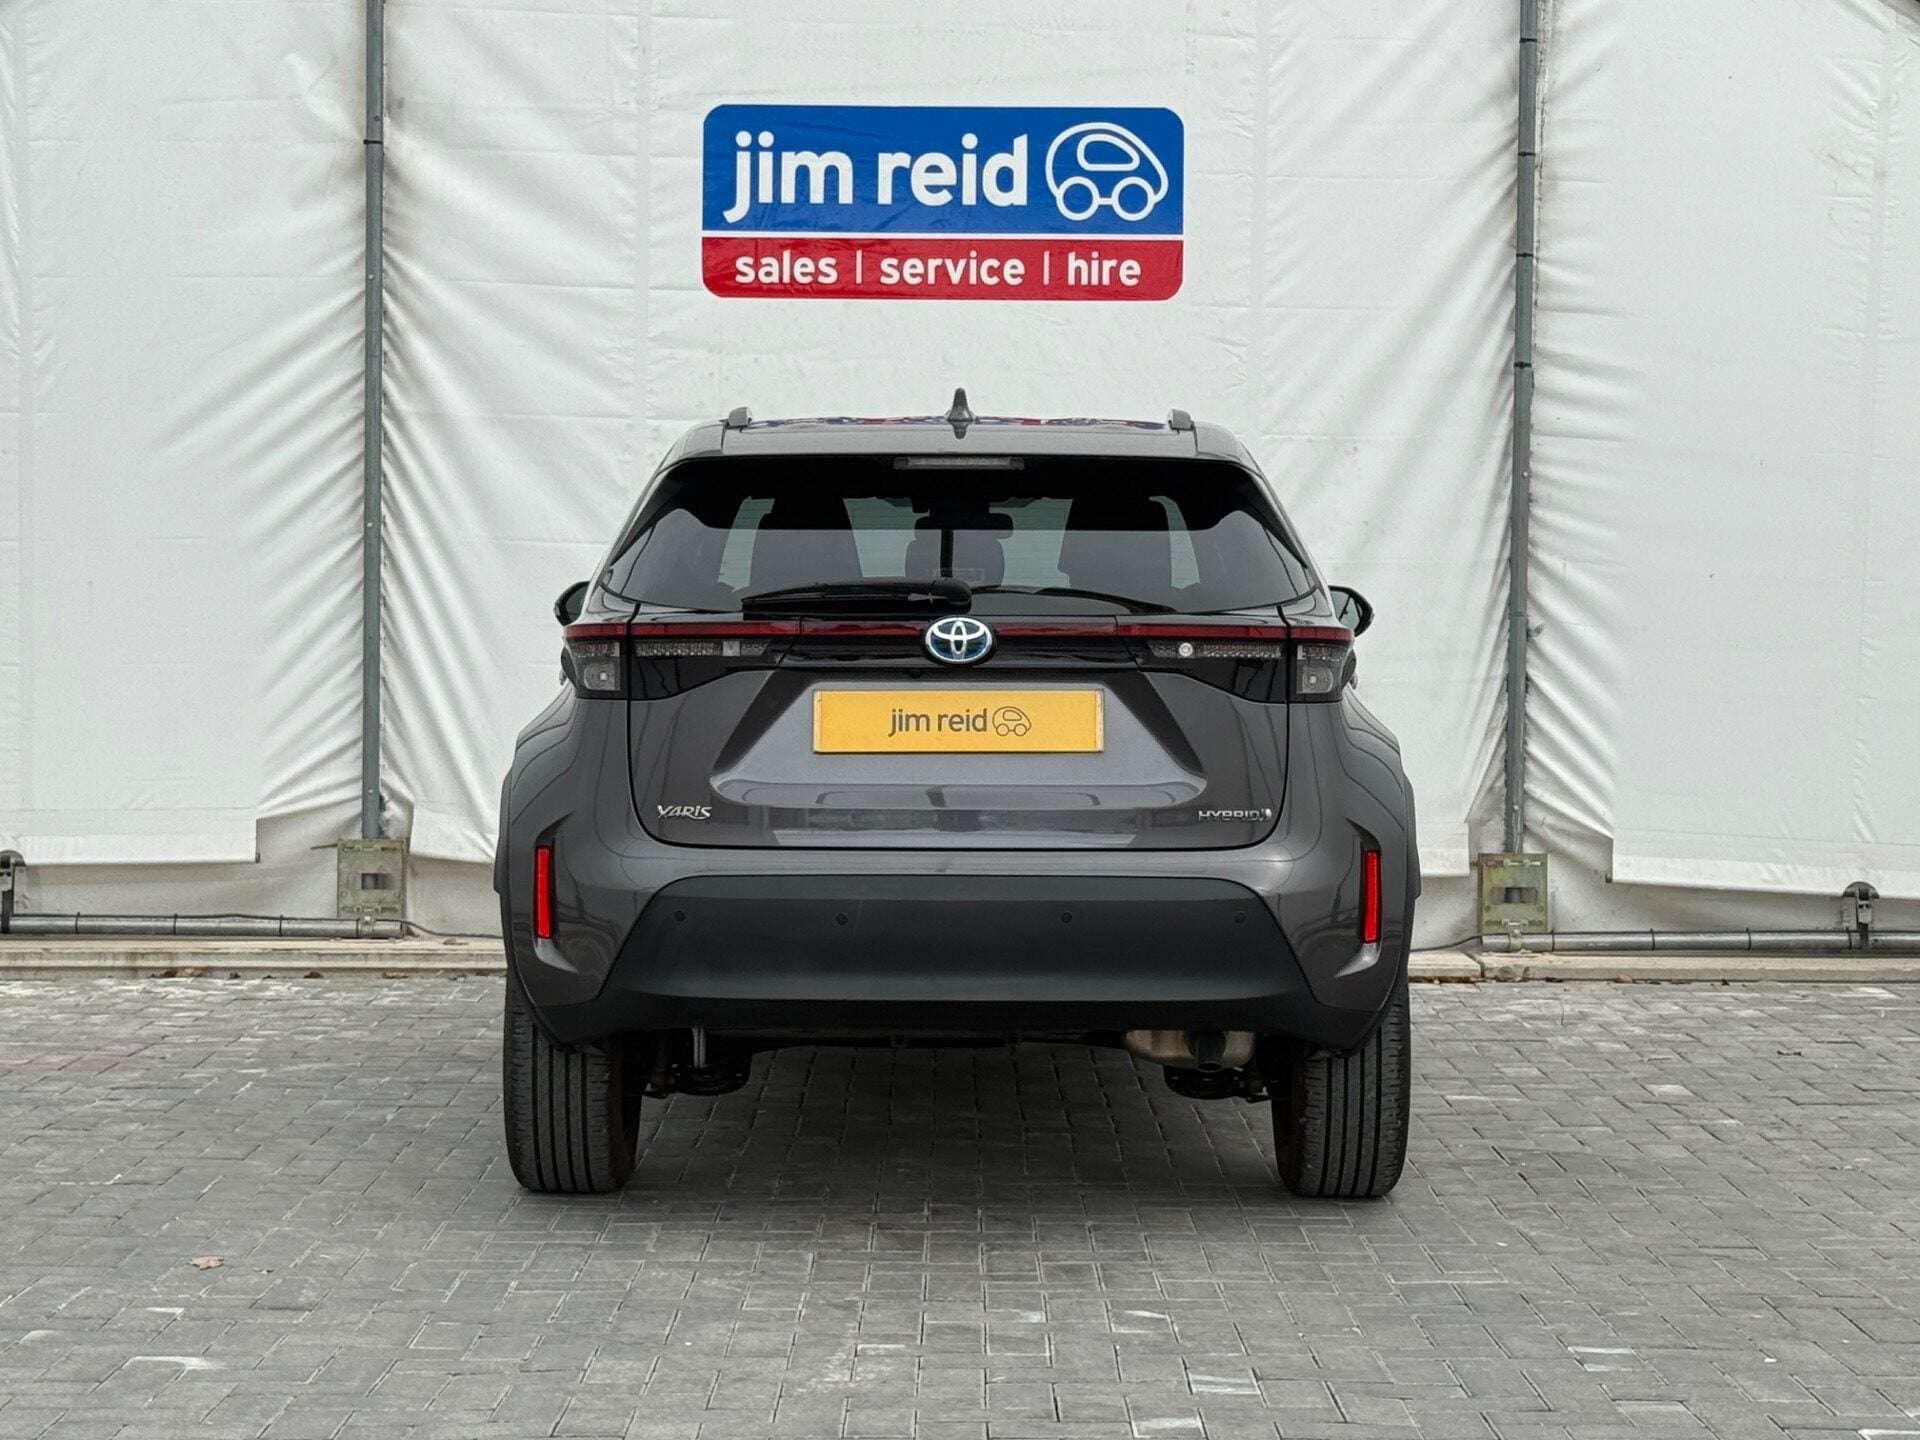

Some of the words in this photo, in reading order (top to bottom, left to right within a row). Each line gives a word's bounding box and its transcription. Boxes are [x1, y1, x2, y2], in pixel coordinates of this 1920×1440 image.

[723, 131, 854, 224] jim
[877, 133, 1028, 207] reid
[735, 249, 838, 285] sales
[880, 251, 1025, 286] service
[1067, 252, 1142, 287] hire
[888, 708, 931, 738] jim
[937, 708, 988, 733] reid
[657, 805, 713, 820] YARIS
